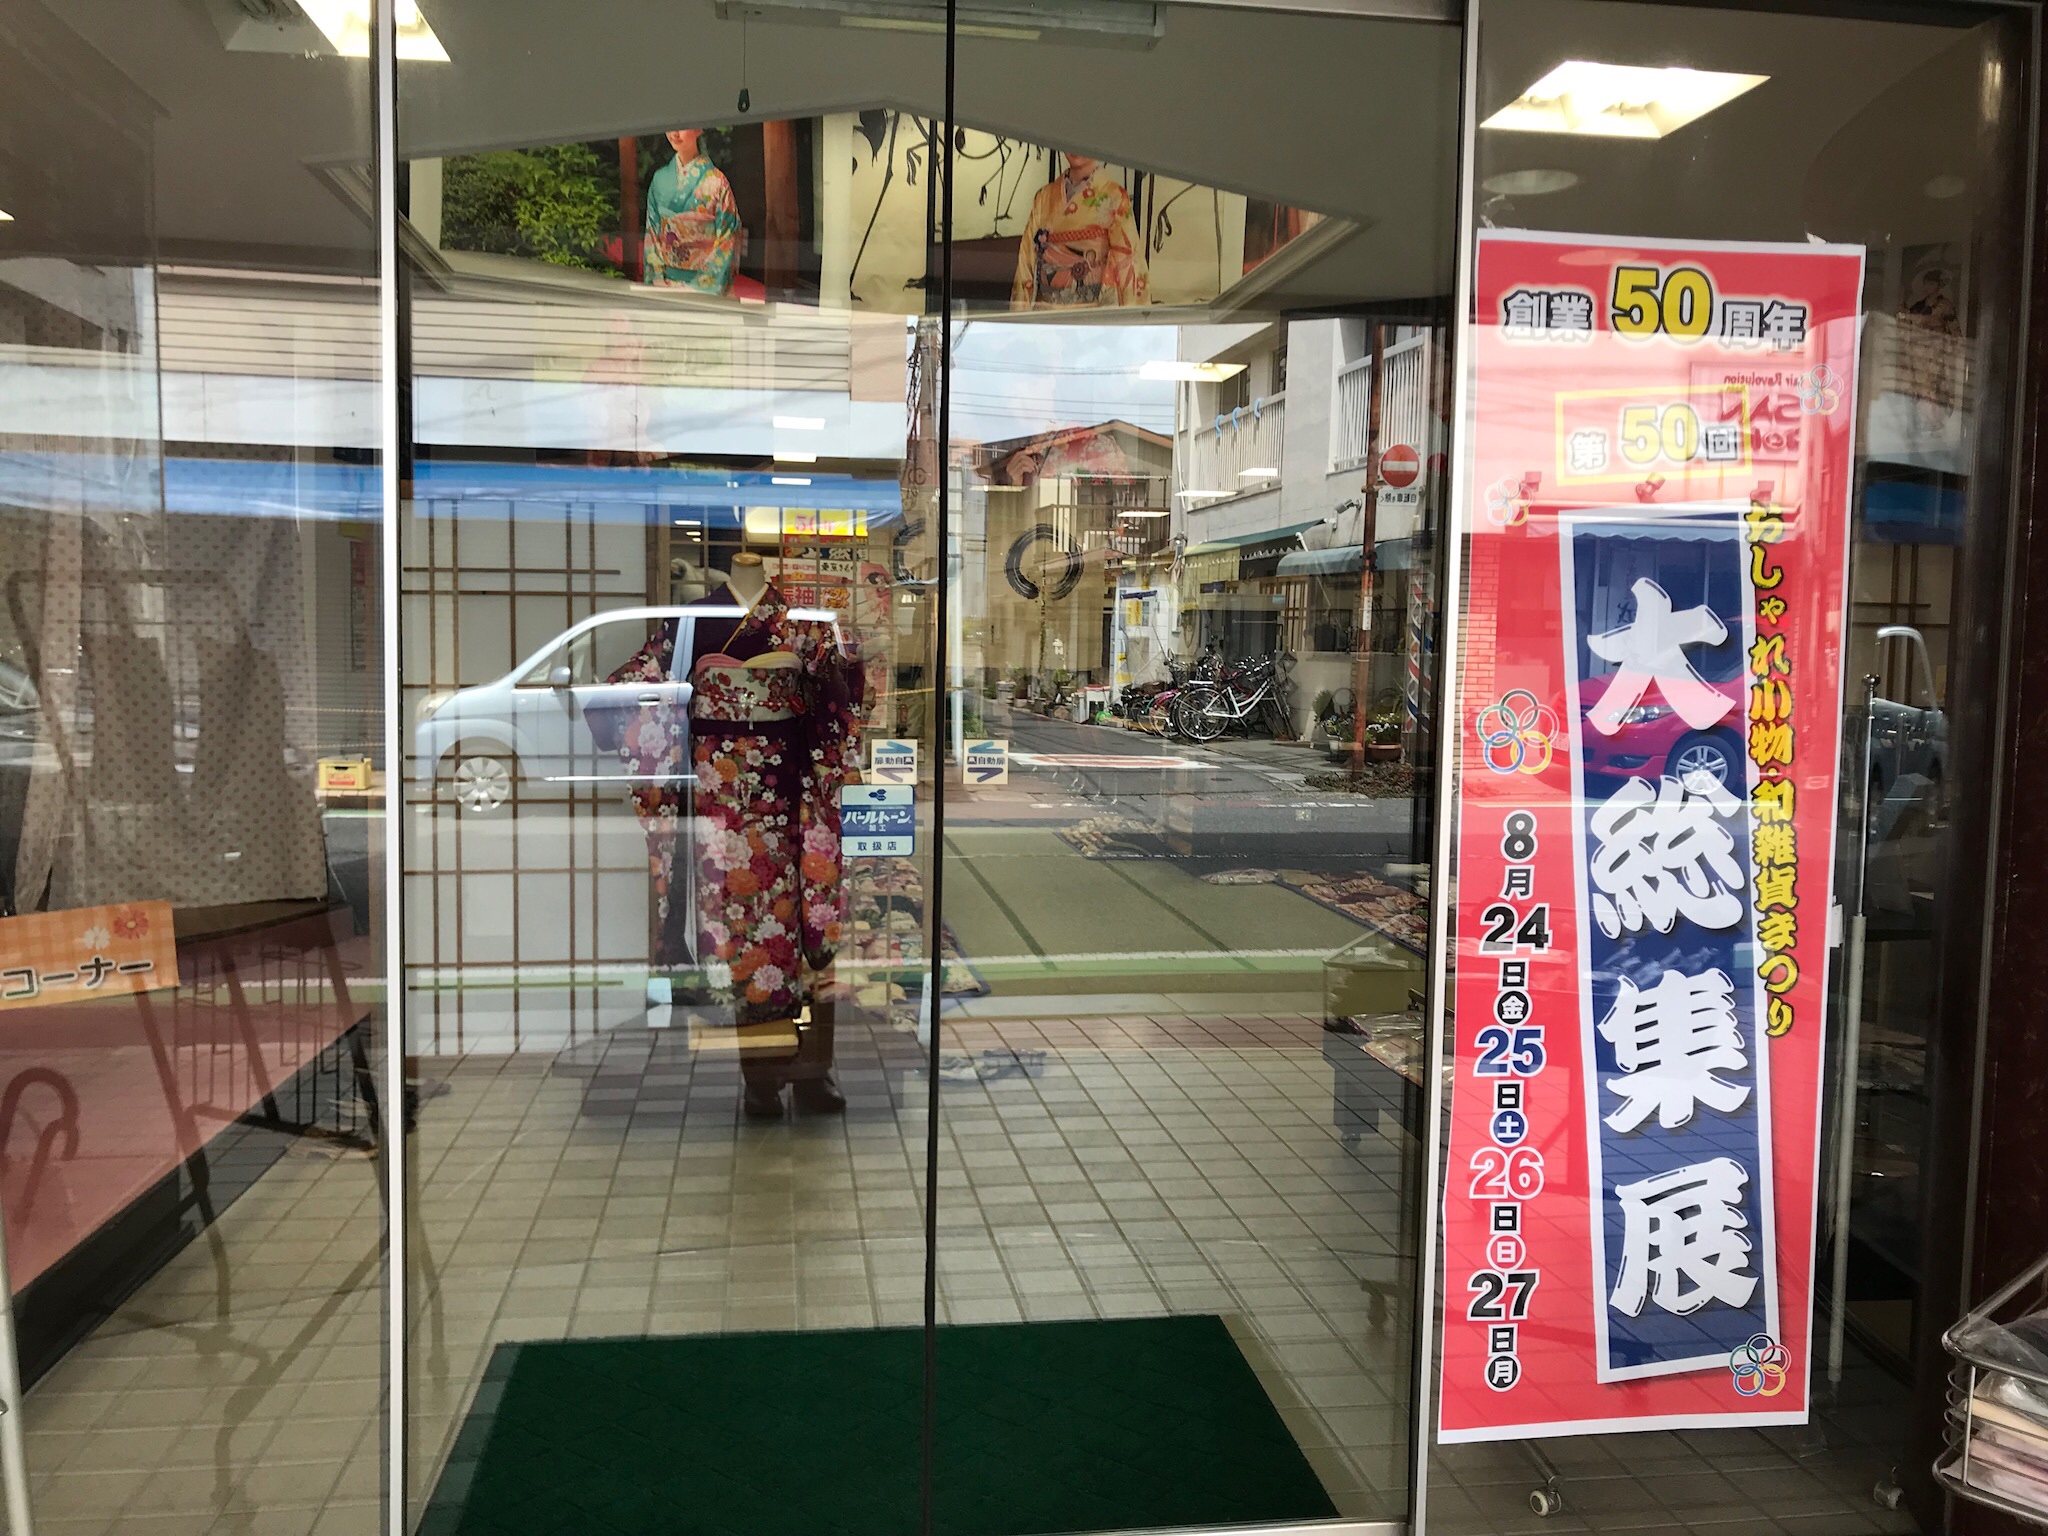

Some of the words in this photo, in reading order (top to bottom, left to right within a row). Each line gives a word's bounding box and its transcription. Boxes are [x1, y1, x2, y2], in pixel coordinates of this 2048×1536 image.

[1503, 266, 1807, 349] 創業50周年
[1570, 404, 1740, 470] 第50回
[977, 756, 1005, 765] 自動扉
[857, 841, 897, 851] 取扱店
[1586, 575, 1760, 1319] 大総集展
